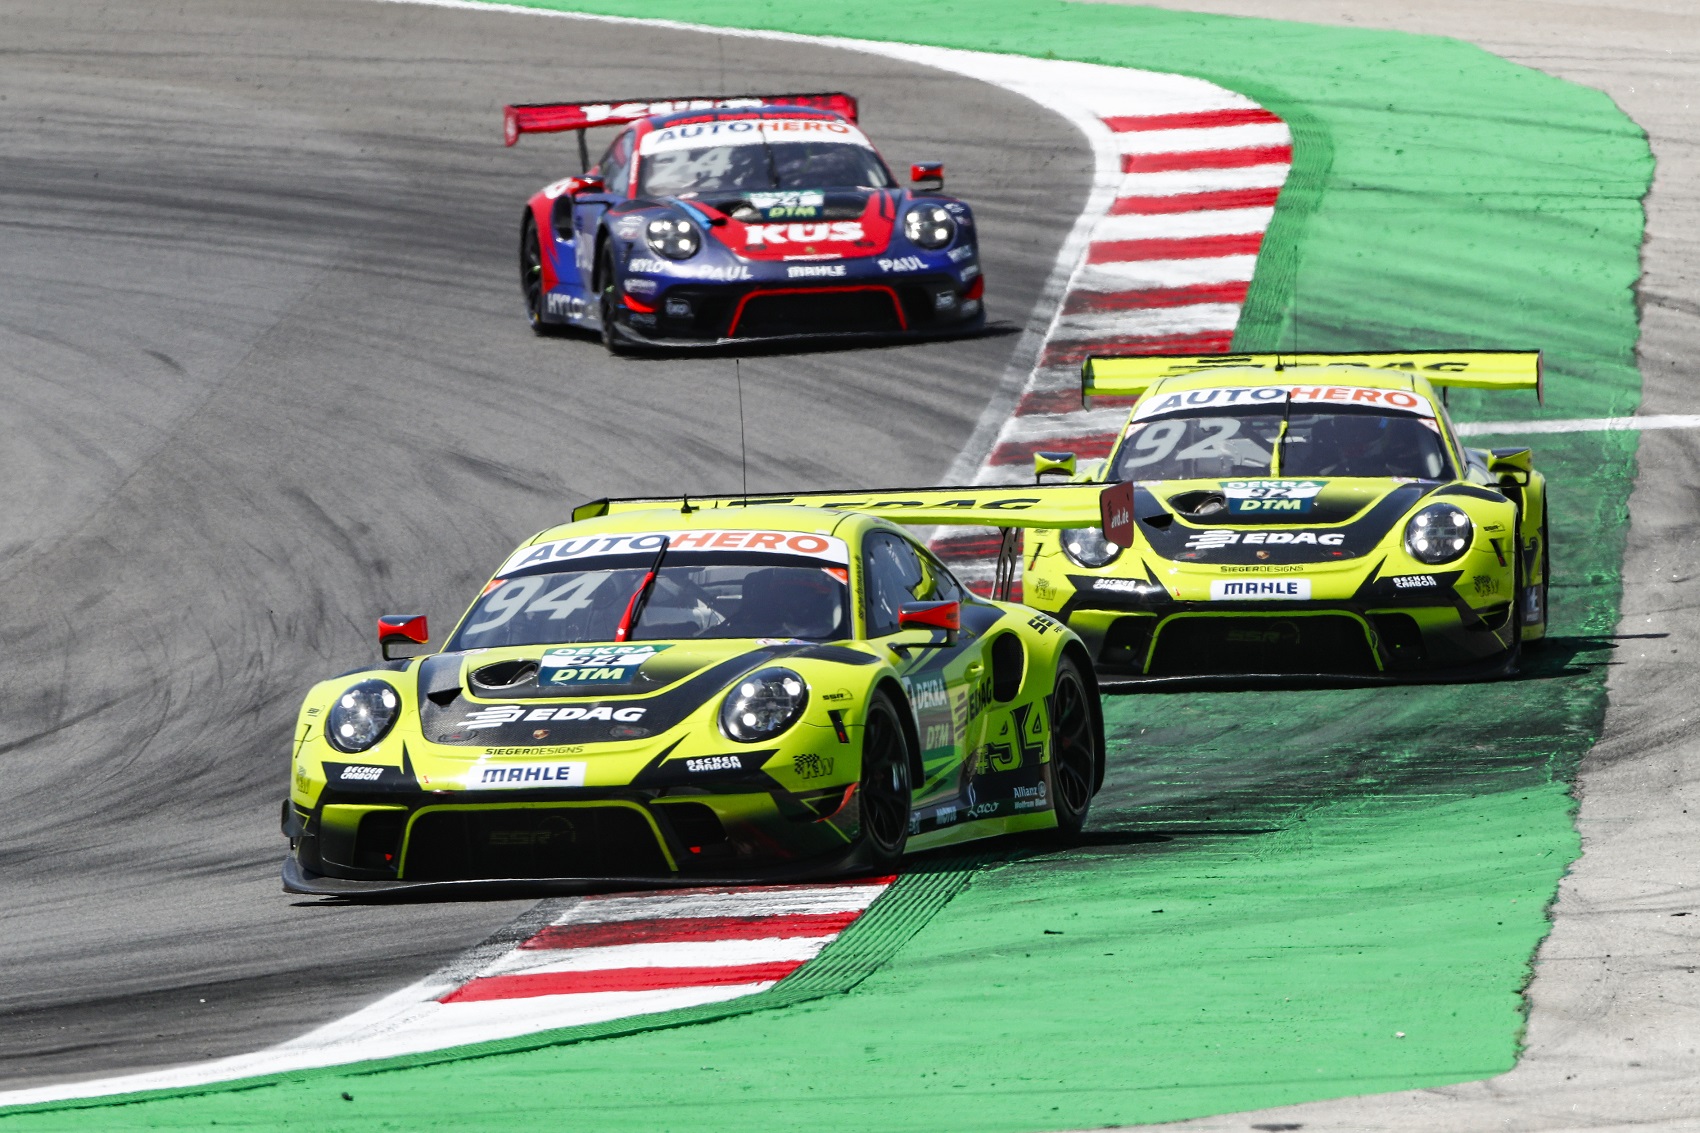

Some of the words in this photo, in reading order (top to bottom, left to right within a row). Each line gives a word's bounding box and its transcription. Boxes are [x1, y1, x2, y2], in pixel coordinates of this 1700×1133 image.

[656, 122, 849, 143] AUTOHERO
[646, 148, 734, 193] 24
[878, 255, 929, 272] PAUL
[788, 265, 847, 277] MAHLE
[1150, 387, 1418, 414] AUTOHERO
[1124, 418, 1242, 469] 92
[1227, 481, 1318, 489] DEKRA
[1240, 499, 1301, 511] DTM
[1243, 533, 1345, 546] EDAG
[517, 532, 829, 567] AUTOHERO
[1224, 582, 1298, 596] MAHLE
[465, 571, 612, 636] 94
[552, 645, 655, 656] DEKRA
[551, 667, 625, 681] DTM
[916, 679, 948, 710] DEKRA
[523, 707, 647, 722] EDAG
[926, 722, 949, 751] DTM
[485, 746, 584, 755] SIEGERDESIGNS
[686, 755, 739, 766] BECKER
[688, 761, 742, 772] CARBON
[340, 773, 381, 781] CARBON
[344, 766, 385, 774] BECKER
[481, 766, 570, 783] MAHLE
[1013, 785, 1038, 799] Allianz
